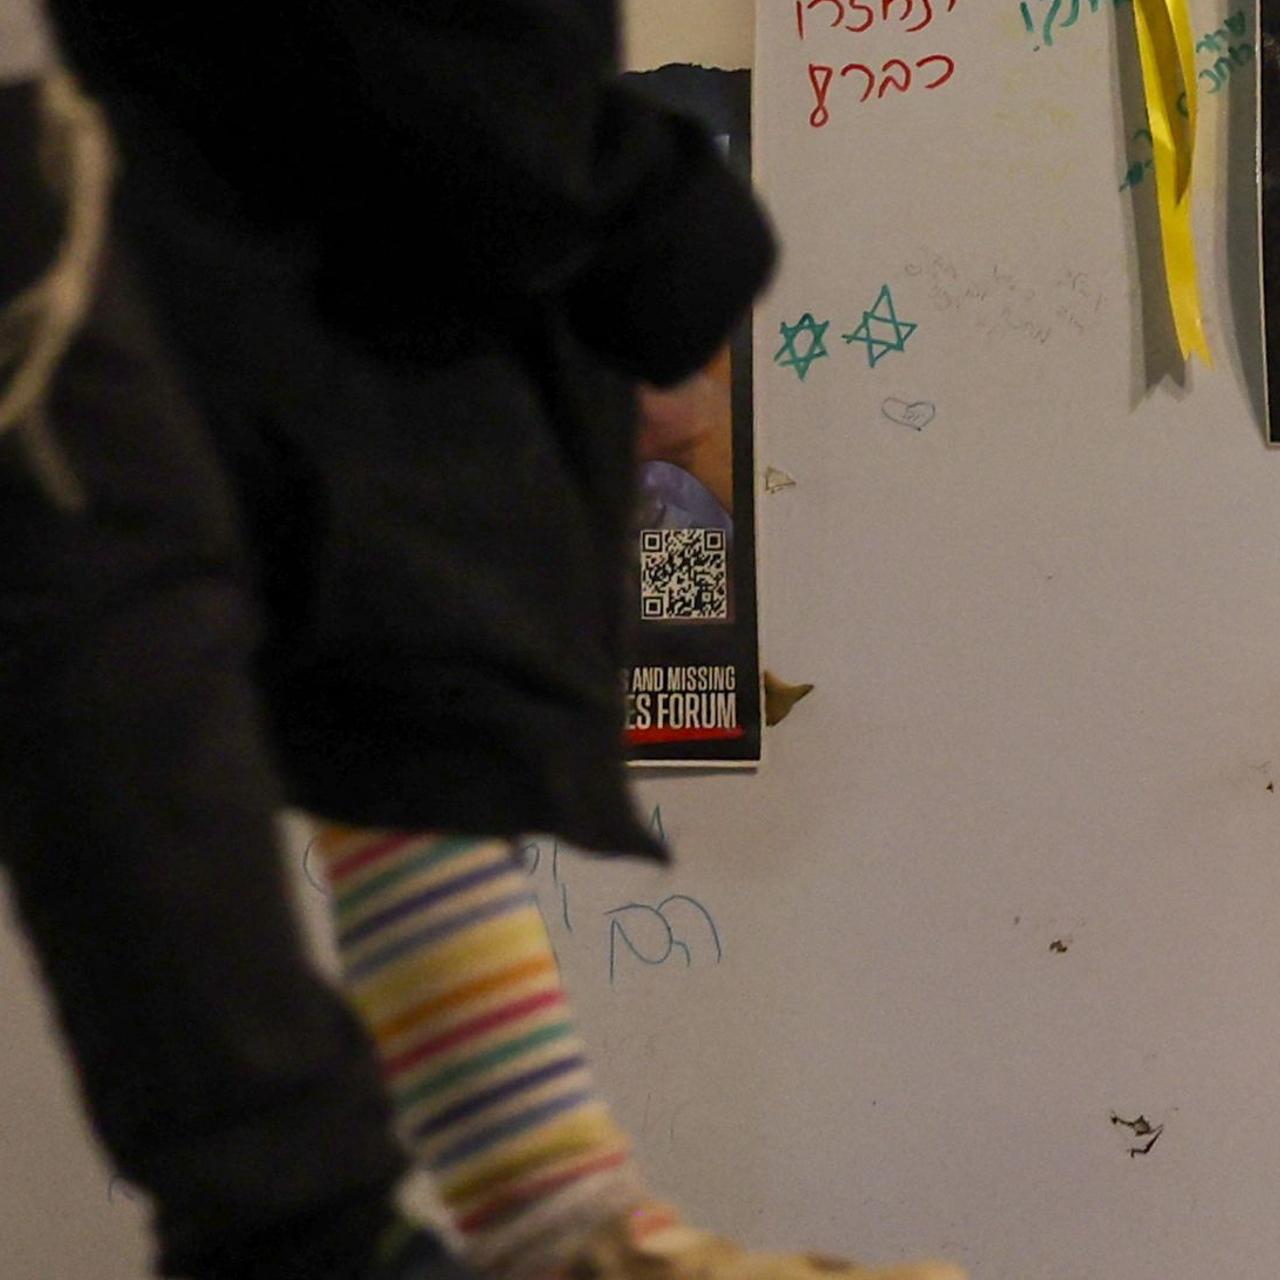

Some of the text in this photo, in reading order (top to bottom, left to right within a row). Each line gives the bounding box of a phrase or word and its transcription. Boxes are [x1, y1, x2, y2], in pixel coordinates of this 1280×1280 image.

[632, 666, 736, 692] AND MISSING
[656, 692, 737, 730] FORUM
